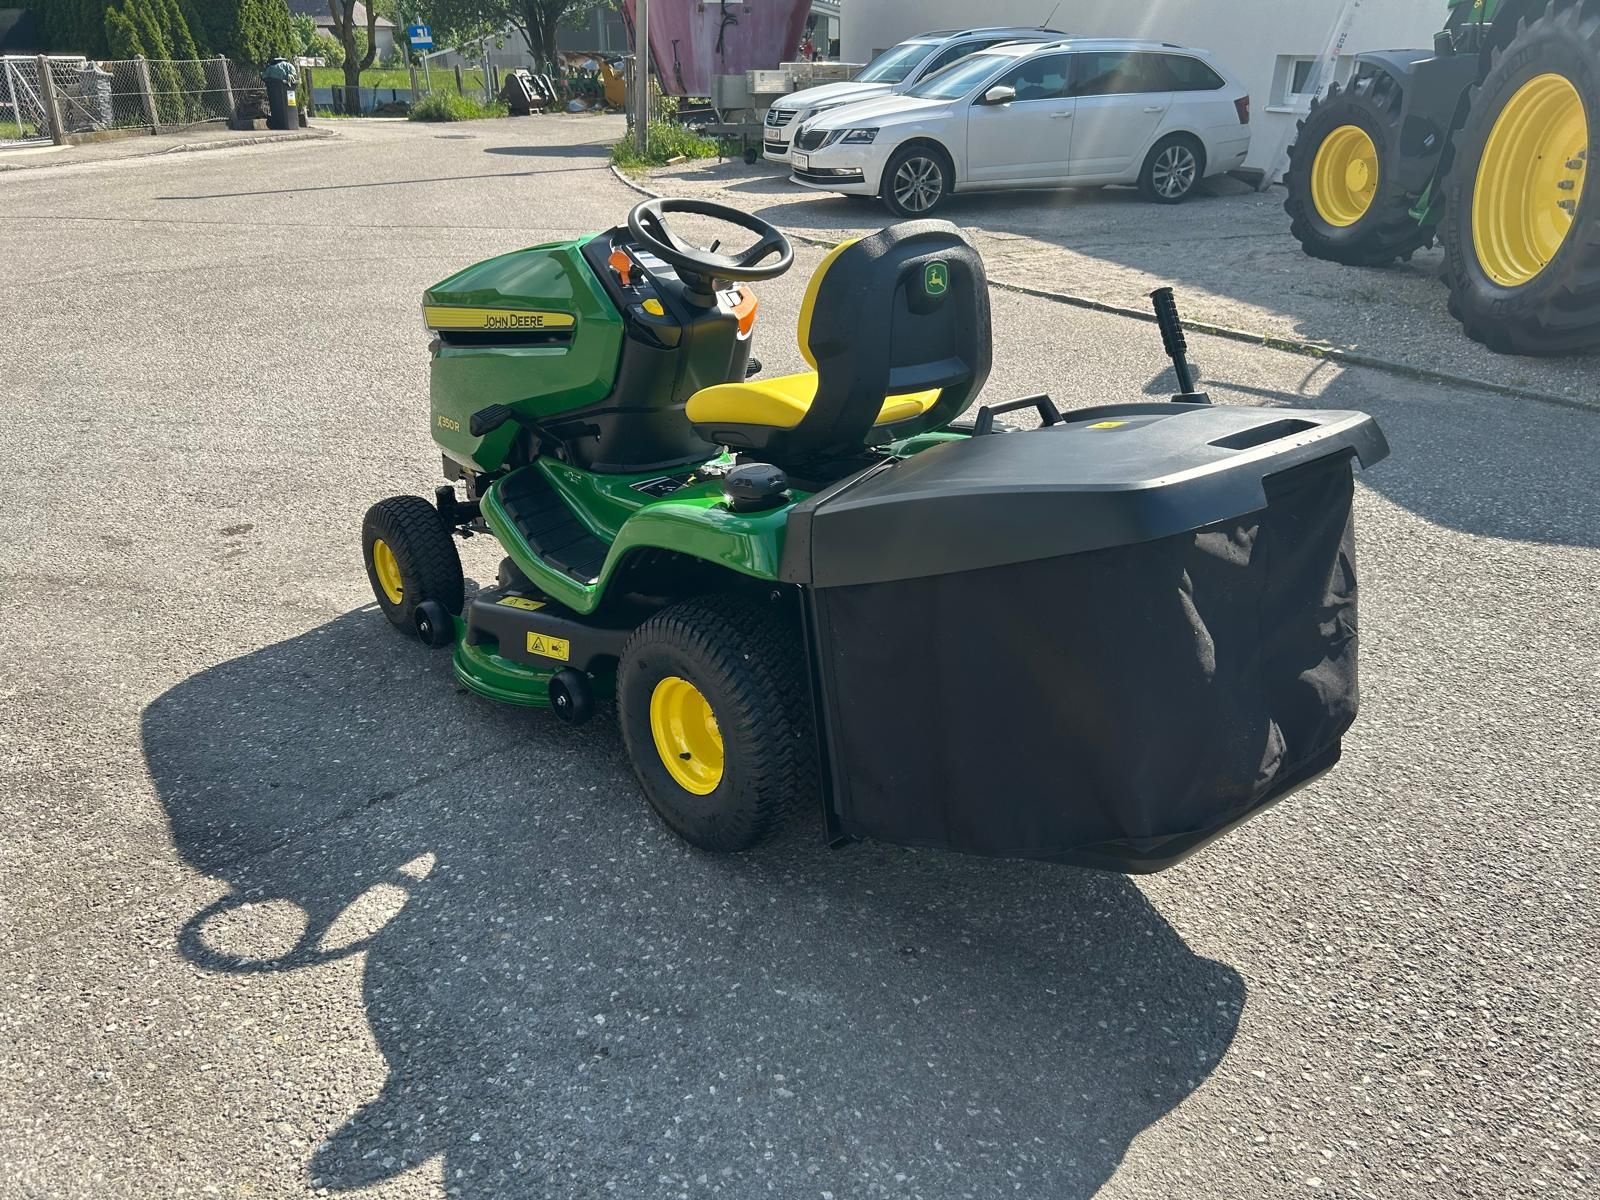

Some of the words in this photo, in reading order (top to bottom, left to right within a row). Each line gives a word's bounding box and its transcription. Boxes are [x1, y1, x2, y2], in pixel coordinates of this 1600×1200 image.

[484, 314, 508, 326] JOHN
[510, 314, 544, 326] DEERE
[437, 415, 460, 432] X350R
